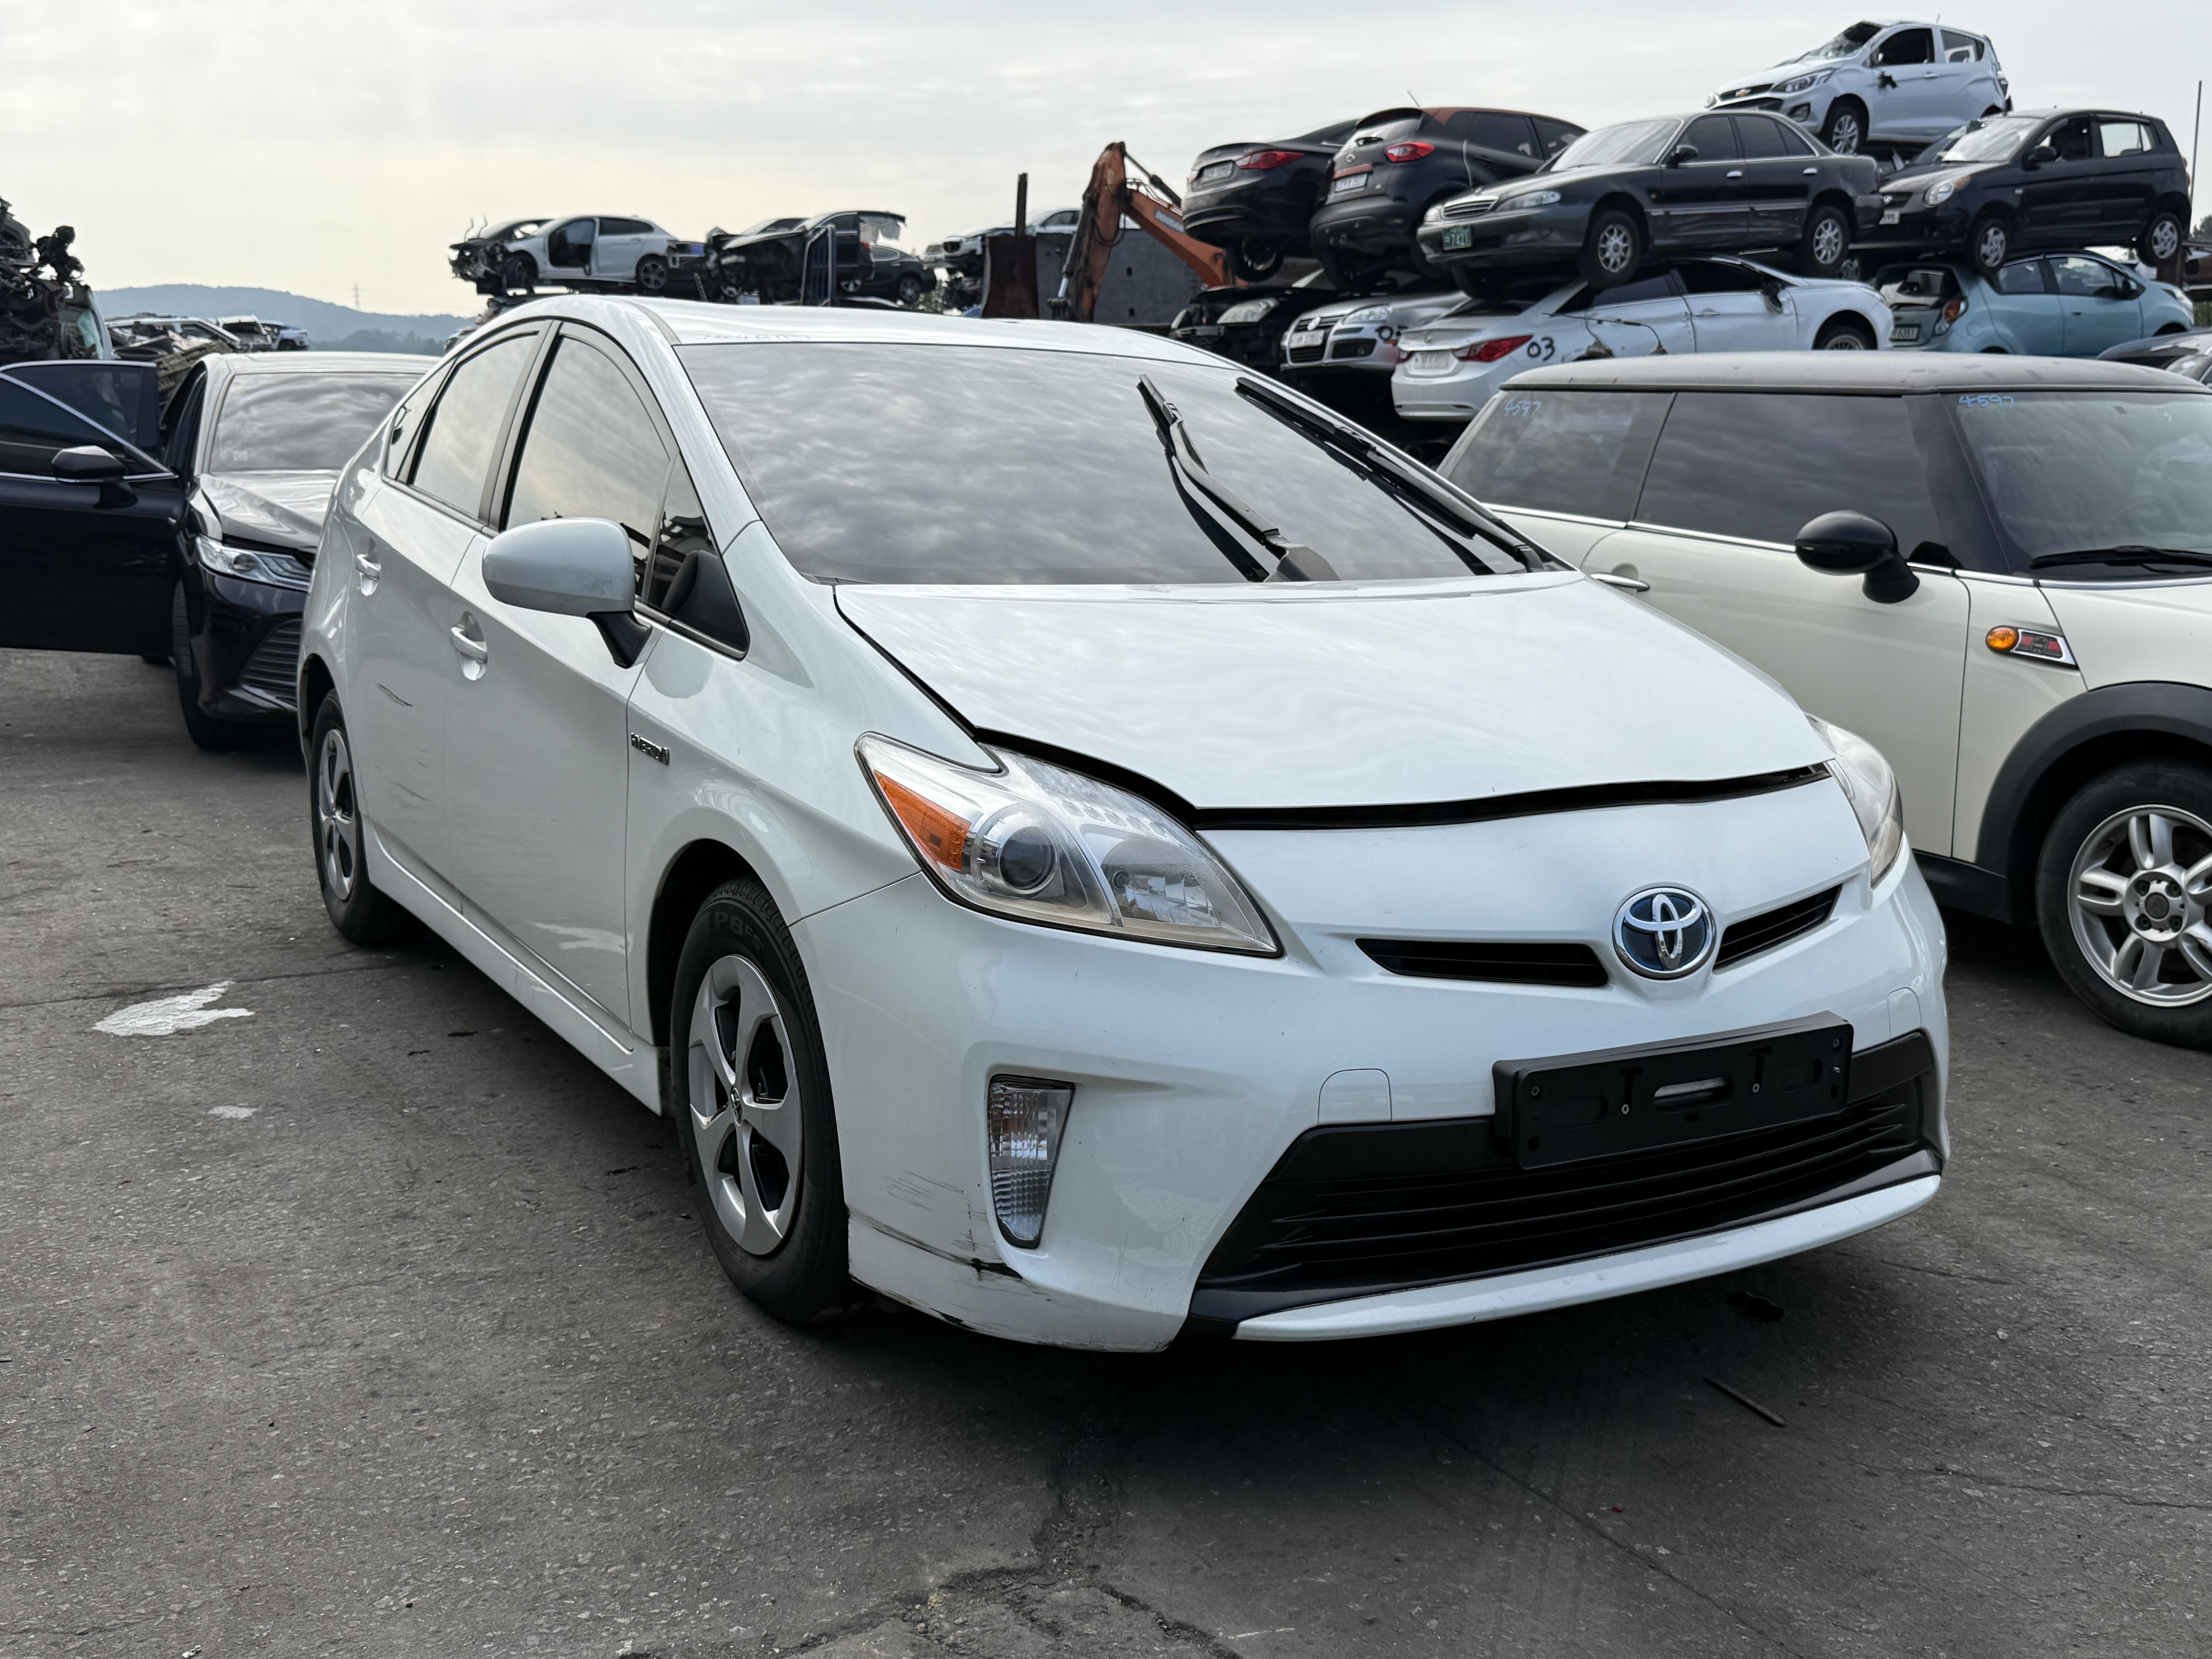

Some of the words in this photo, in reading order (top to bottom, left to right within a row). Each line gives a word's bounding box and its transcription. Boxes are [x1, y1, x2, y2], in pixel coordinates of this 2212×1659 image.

[1527, 337, 1555, 361] 03
[1504, 395, 1542, 417] 4597
[1958, 394, 2014, 408] 4597
